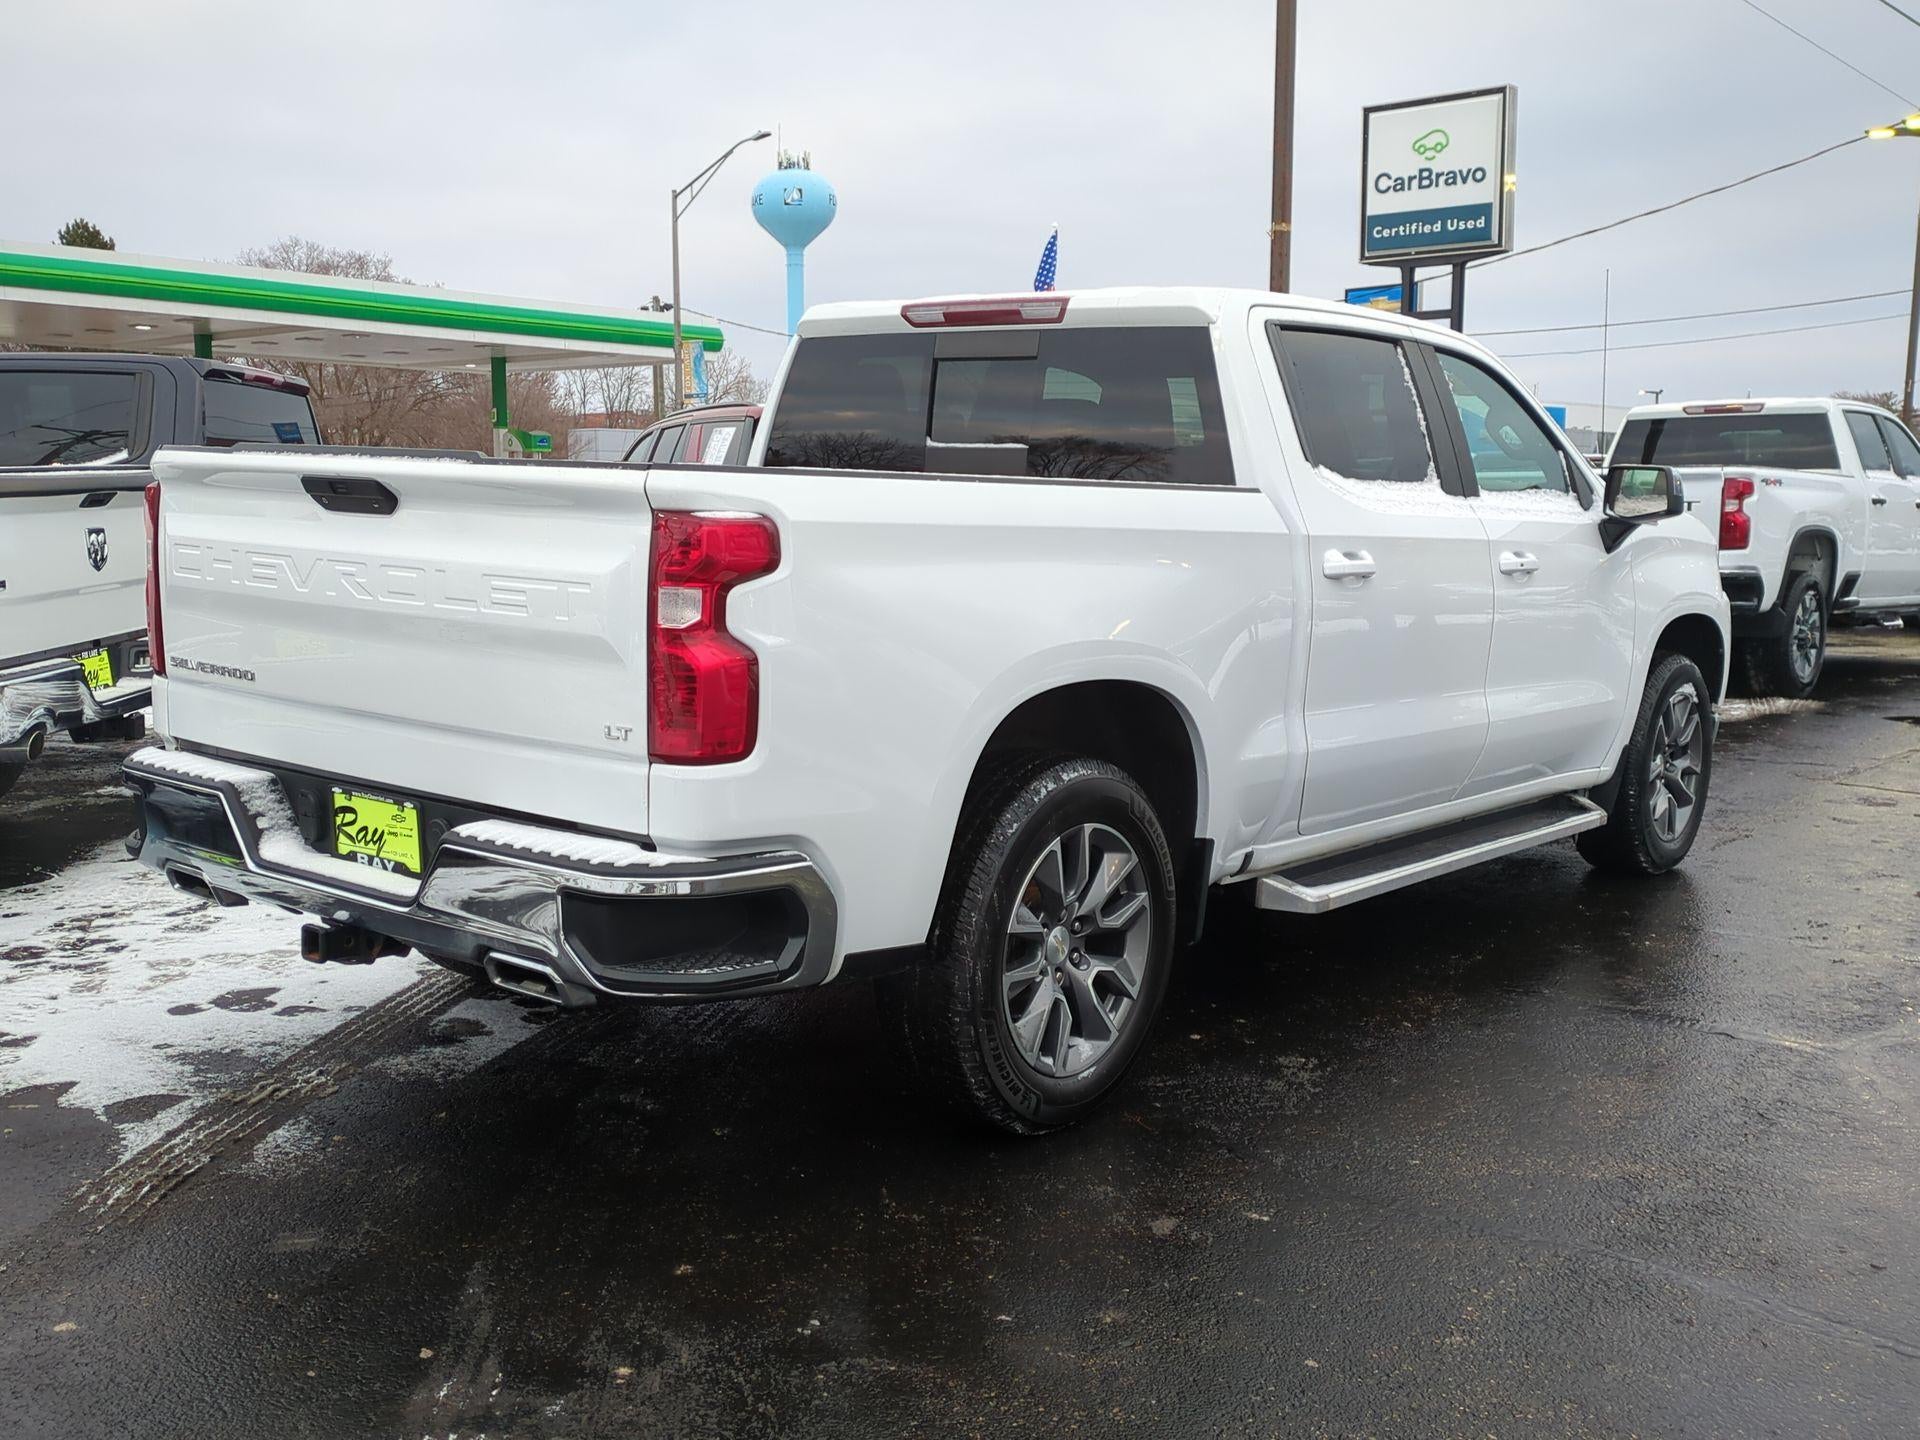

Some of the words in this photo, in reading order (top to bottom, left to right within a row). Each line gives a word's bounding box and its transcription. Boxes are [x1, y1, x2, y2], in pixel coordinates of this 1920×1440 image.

[1374, 166, 1487, 194] CarBravo
[1373, 220, 1442, 238] Certified
[1447, 216, 1486, 231] Used
[173, 543, 592, 621] CHEVROLET
[170, 656, 256, 682] SILVERADO
[603, 725, 632, 741] LT
[335, 805, 387, 858] Ray
